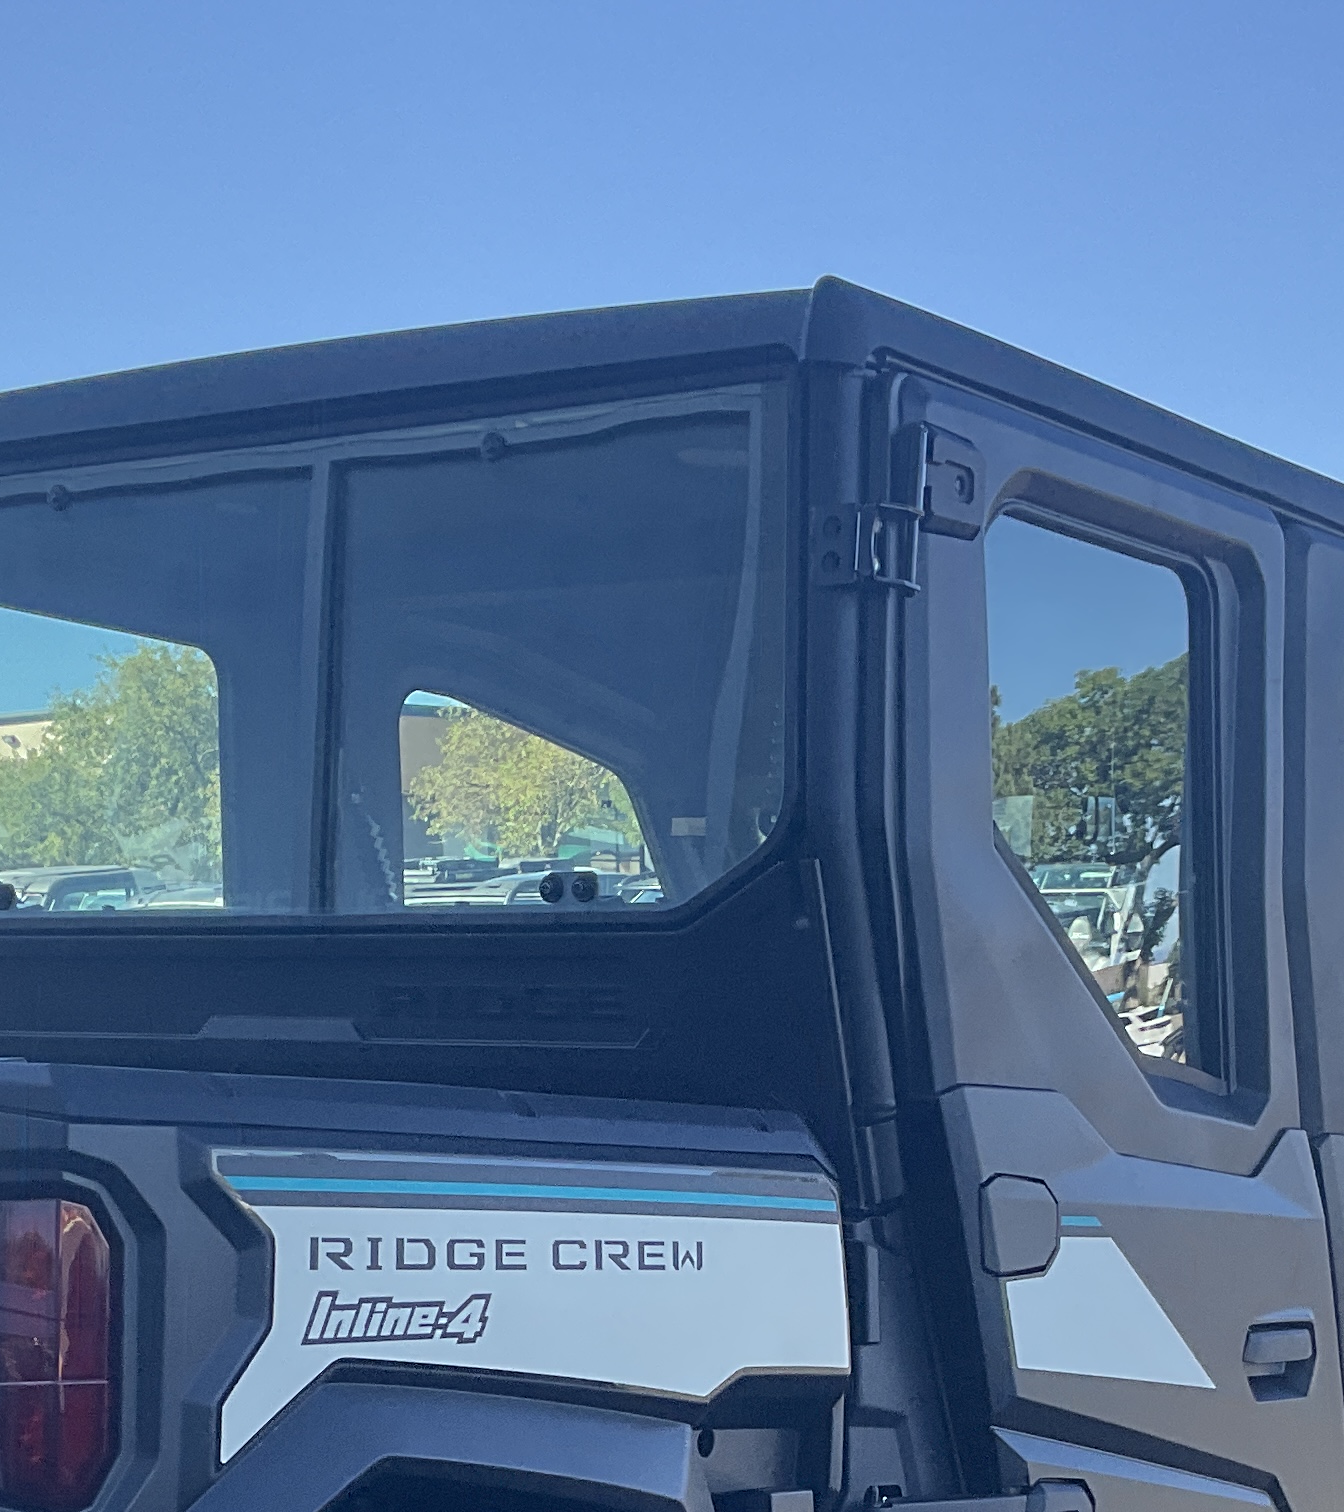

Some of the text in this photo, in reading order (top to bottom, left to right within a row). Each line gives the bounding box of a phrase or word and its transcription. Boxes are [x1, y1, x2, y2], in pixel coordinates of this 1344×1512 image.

[308, 1236, 704, 1272] RIDGE CREW
[301, 1290, 492, 1346] Inline-4
